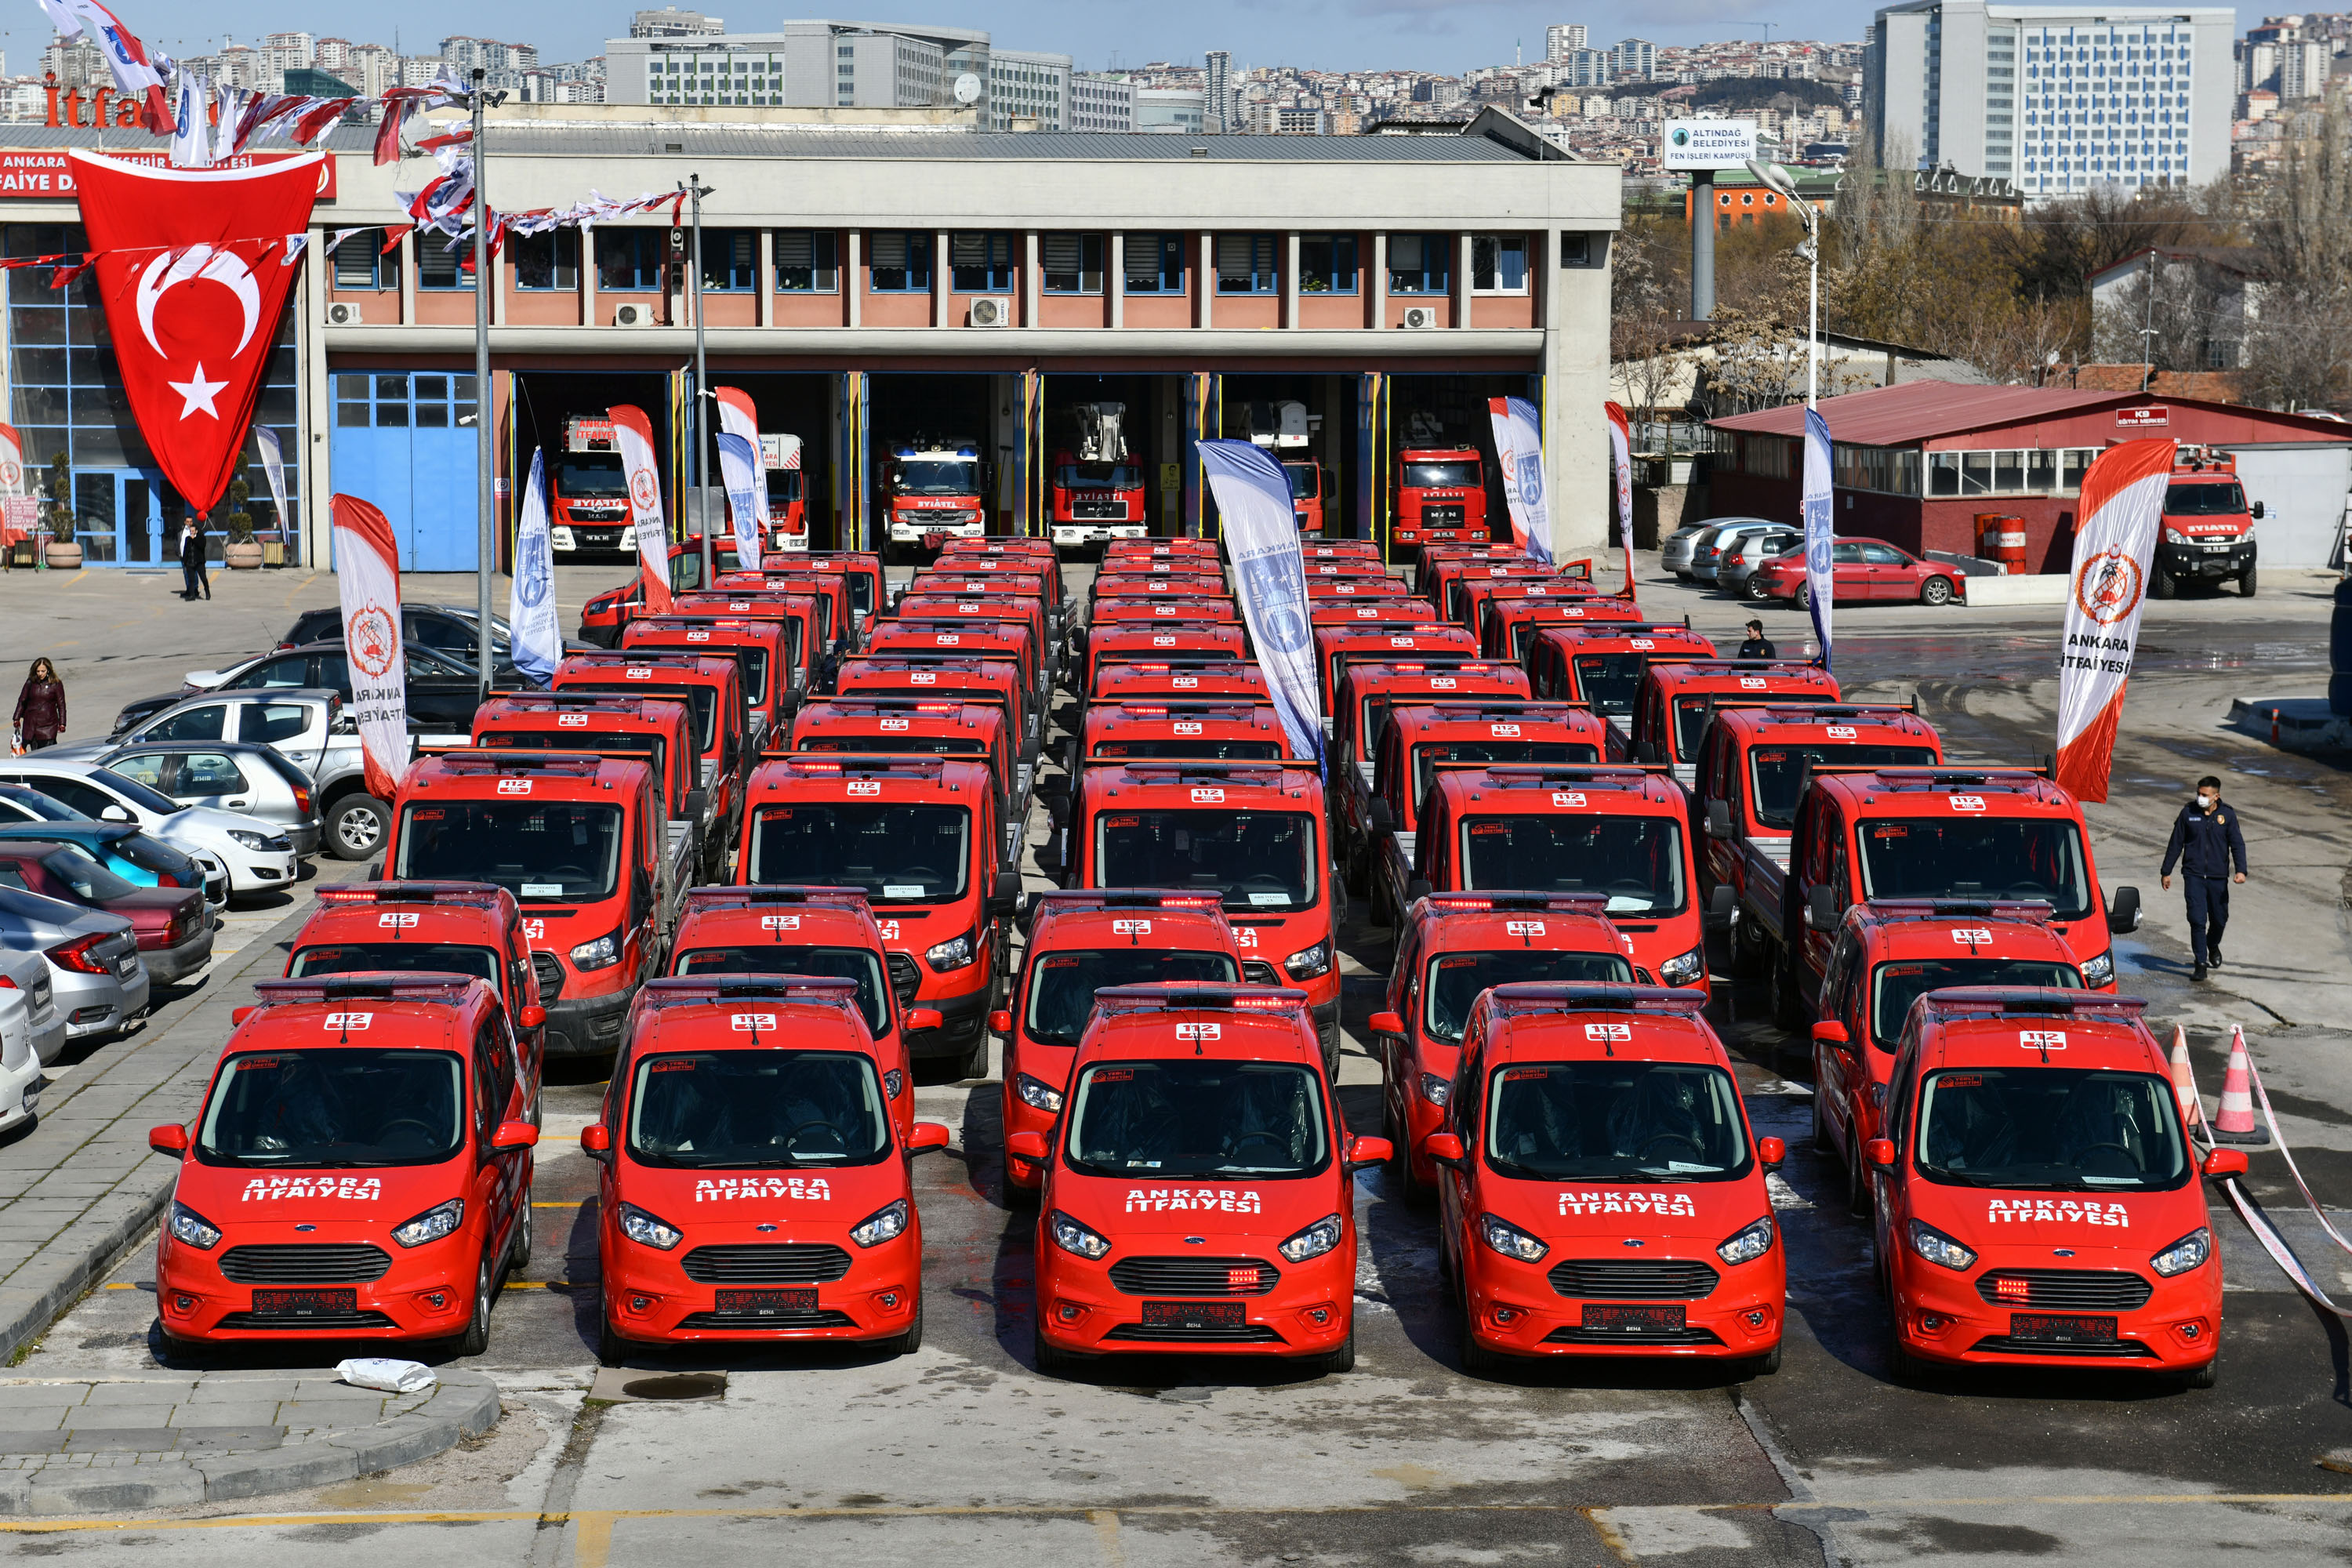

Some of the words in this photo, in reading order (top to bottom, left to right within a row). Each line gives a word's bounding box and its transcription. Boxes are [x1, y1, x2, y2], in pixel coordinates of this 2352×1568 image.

[1693, 128, 1741, 137] ALTINDAĞ
[1693, 138, 1749, 147] BELEDİYESİ
[3, 157, 66, 168] ANKARA
[2068, 634, 2128, 652] ANKARA
[2061, 653, 2129, 674] İTFAİYESİ
[246, 1178, 381, 1189] ANKARA
[696, 1178, 829, 1189] ANKARA
[242, 1186, 380, 1202] İTFAİYESİ
[696, 1187, 830, 1202] İTFAİYESİ
[1127, 1189, 1260, 1201] ANKARA
[1559, 1192, 1693, 1203] ANKARA
[1126, 1198, 1260, 1214] İTFAİYESİ
[1559, 1201, 1695, 1217] İTFAİYESİ
[1989, 1200, 2127, 1214] ANKARA
[1989, 1209, 2129, 1227] İTFAİYESİ
